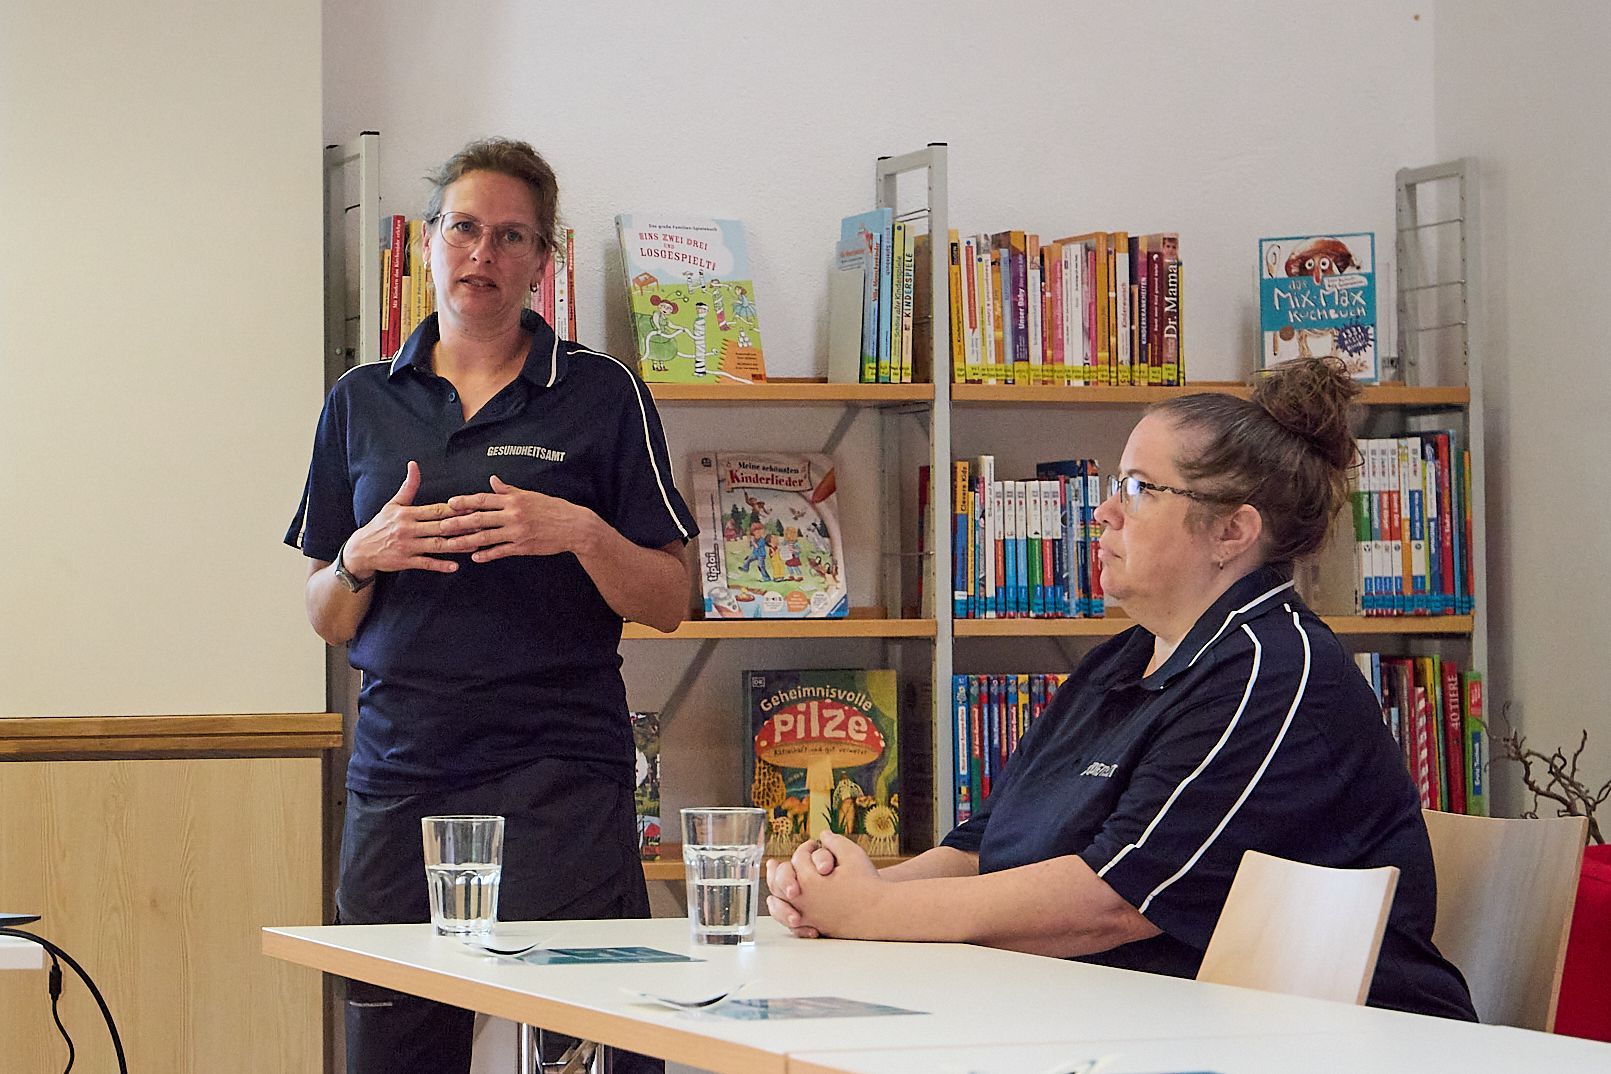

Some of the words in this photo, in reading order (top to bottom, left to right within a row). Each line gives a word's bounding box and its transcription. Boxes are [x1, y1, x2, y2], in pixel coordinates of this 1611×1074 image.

[638, 232, 659, 240] EINS
[662, 234, 684, 244] ZWEI
[686, 238, 708, 250] DREI
[640, 248, 717, 271] LOSGESPIELT!
[904, 252, 913, 318] KINDERSPIELE
[1164, 259, 1178, 312] Mama!
[1164, 316, 1178, 338] Dr.
[487, 446, 566, 462] GESUNDHEITSAMT
[730, 470, 804, 486] Kinderlieder
[738, 462, 760, 470] Meine
[762, 465, 800, 474] schönsten
[706, 552, 719, 582] tiptoi
[760, 685, 872, 712] Geheimnisvolle
[1448, 674, 1460, 711] TIERE
